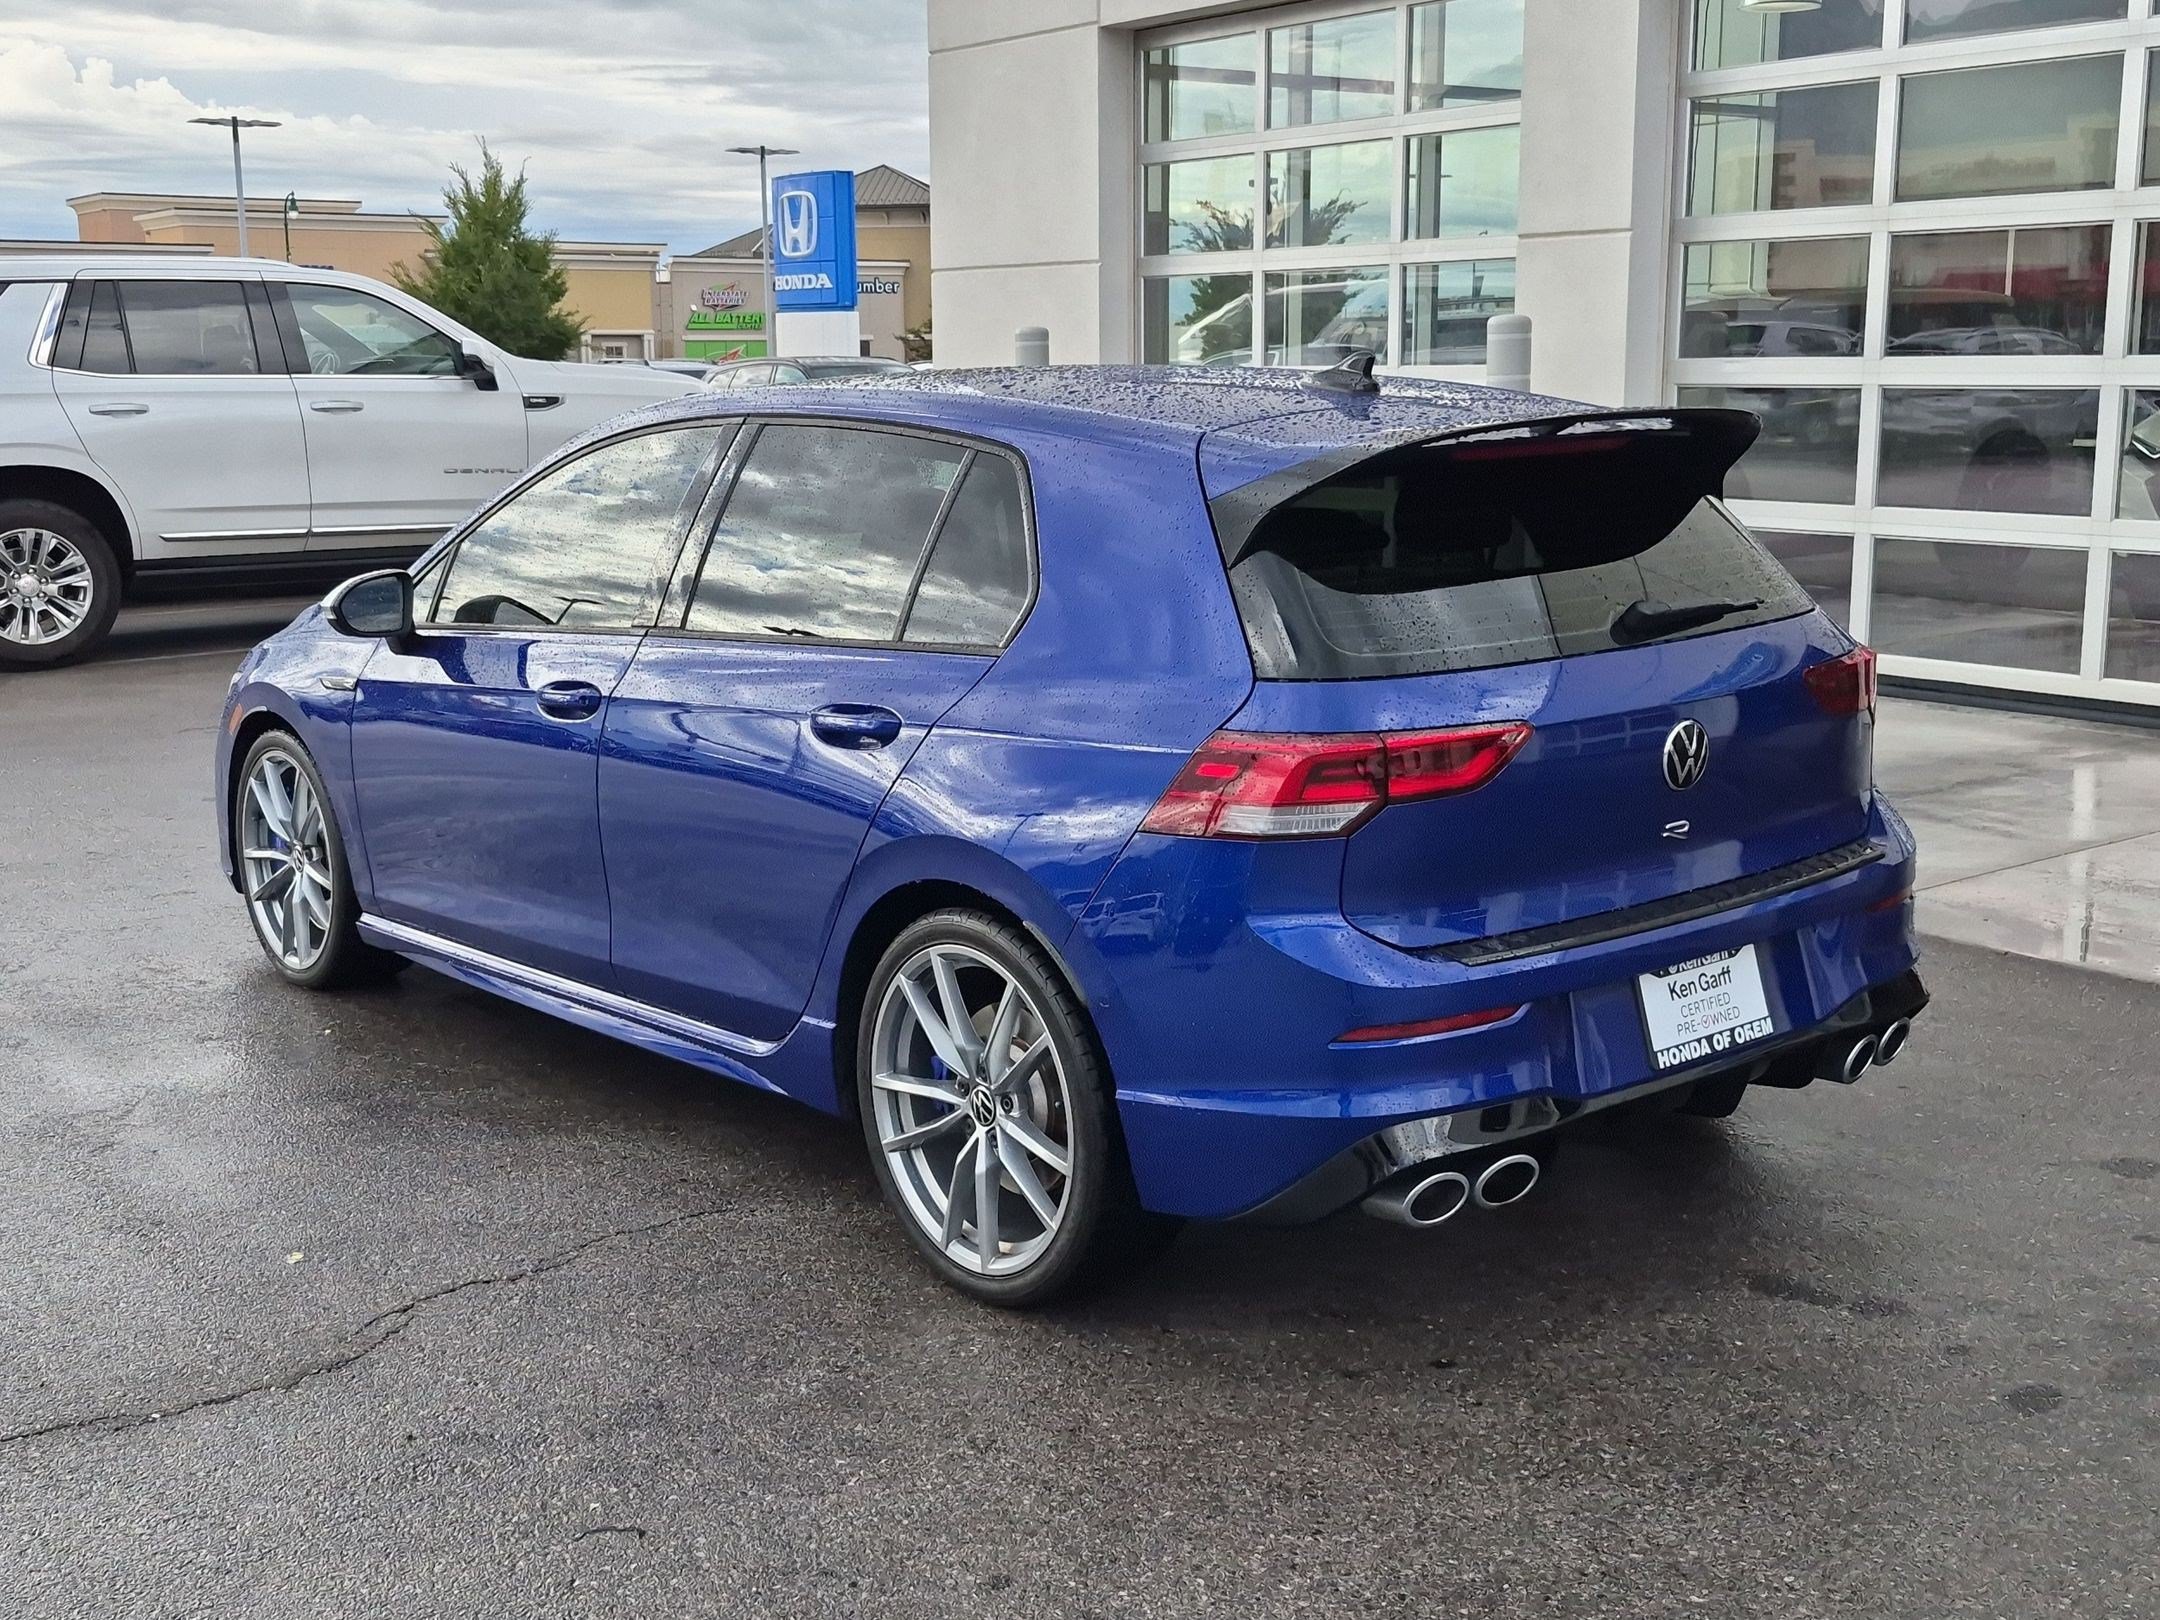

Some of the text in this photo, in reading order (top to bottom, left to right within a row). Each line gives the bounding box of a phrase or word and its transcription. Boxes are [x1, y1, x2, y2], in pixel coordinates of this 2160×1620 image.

[774, 273, 833, 291] HONDA
[689, 311, 709, 323] ALL
[1667, 965, 1732, 1001] Ken Garff
[1680, 992, 1731, 1018] CERTIFIED
[1656, 1016, 1774, 1070] HONDA OF OREM
